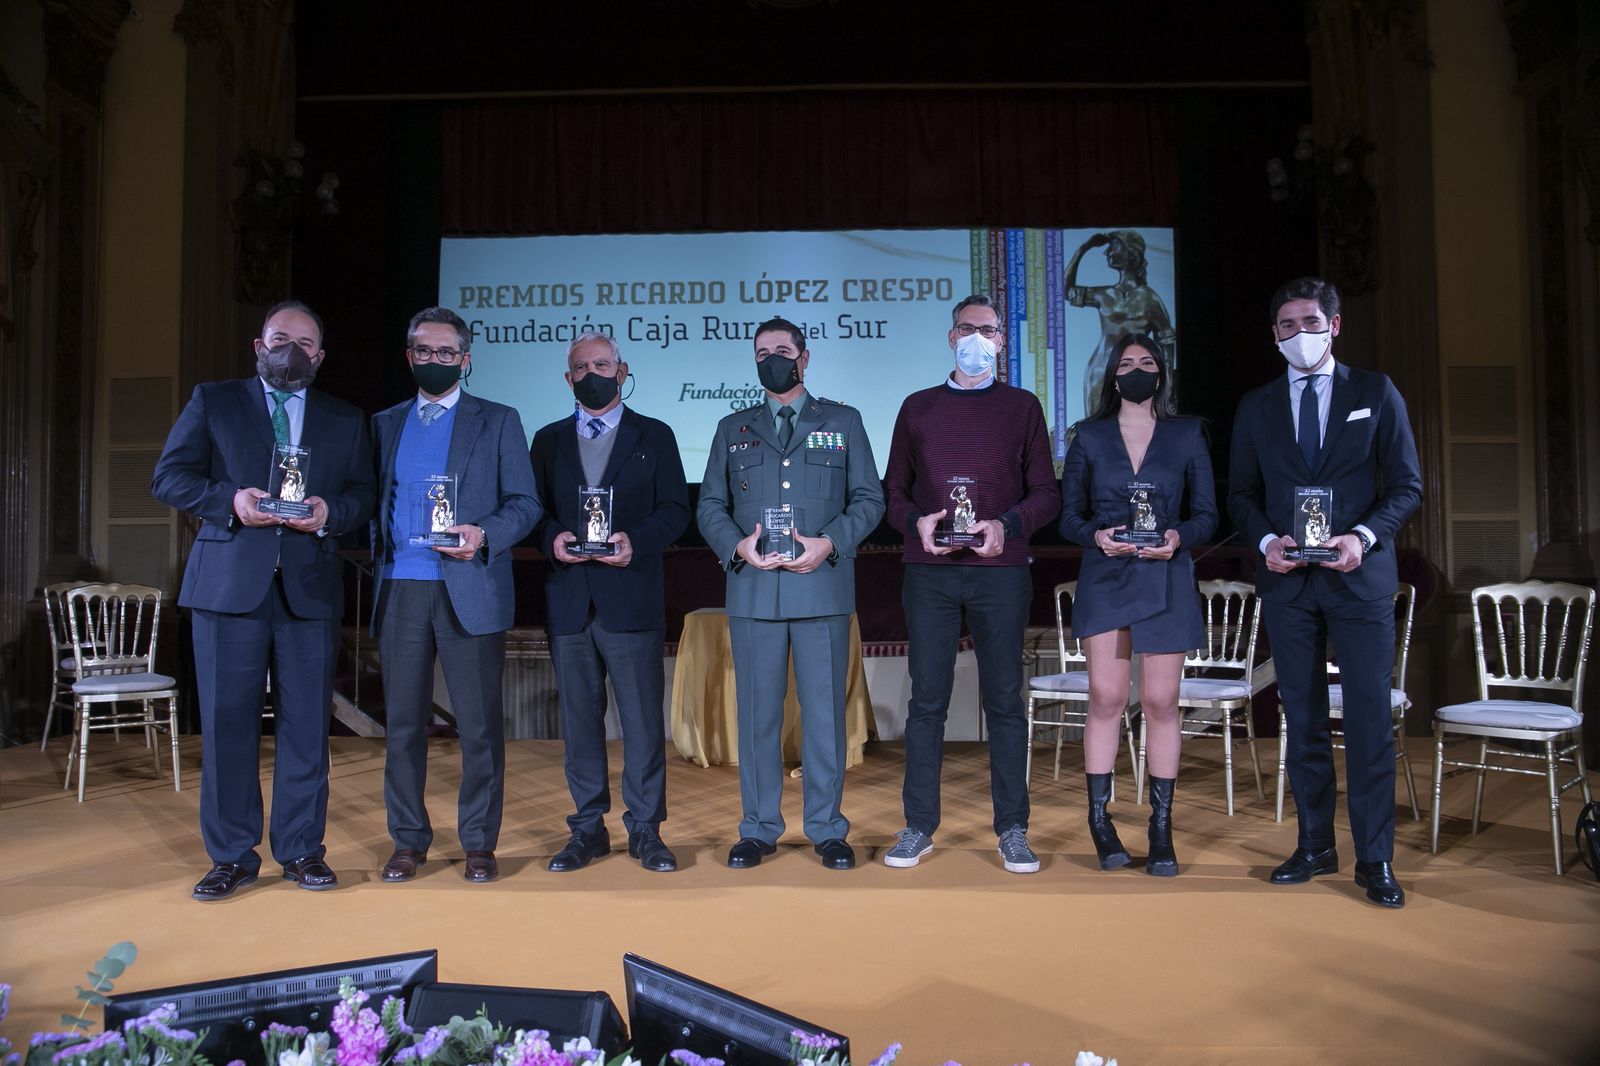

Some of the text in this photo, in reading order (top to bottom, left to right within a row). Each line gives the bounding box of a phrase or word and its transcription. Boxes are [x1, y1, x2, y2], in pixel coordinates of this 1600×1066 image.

[458, 283, 585, 309] PREMIOS
[595, 280, 726, 306] RICARDO
[739, 272, 829, 304] LÓPEZ
[842, 277, 953, 302] CRESPO
[1015, 231, 1026, 315] Acción Social Solidaria
[470, 314, 617, 344] Fundación
[628, 314, 689, 349] Caja
[837, 313, 888, 339] Sur
[678, 382, 766, 402] Fundación
